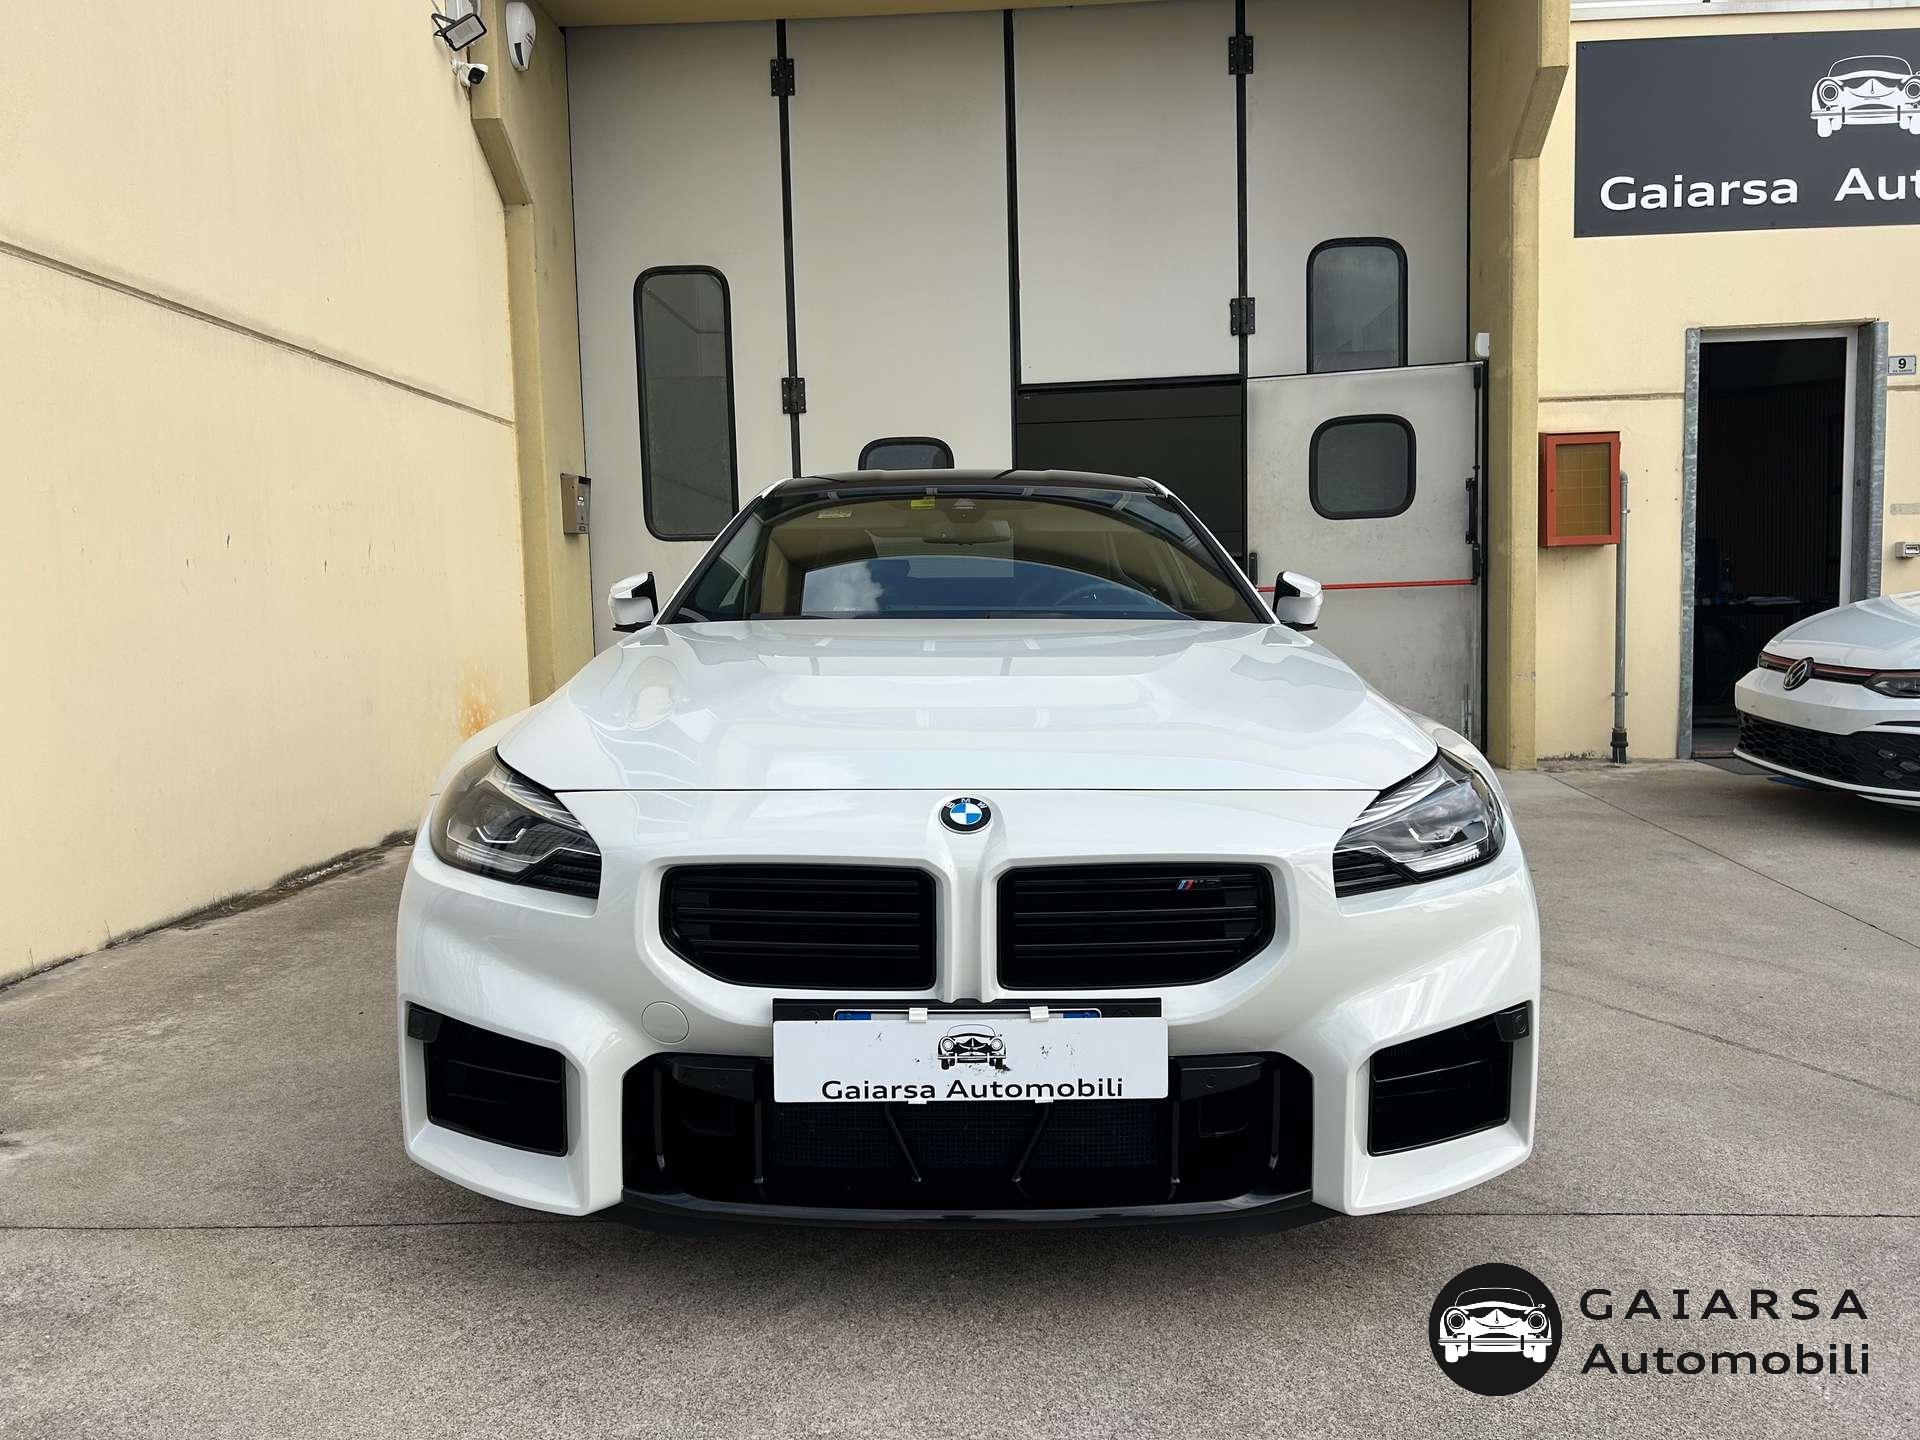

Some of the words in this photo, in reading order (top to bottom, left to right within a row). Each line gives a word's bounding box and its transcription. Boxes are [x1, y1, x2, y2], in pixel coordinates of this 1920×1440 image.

[1600, 174, 1798, 211] Gaiarsa
[1898, 358, 1906, 369] 9
[944, 798, 987, 809] BMW
[821, 1079, 936, 1100] Gaiarsa
[946, 1077, 1123, 1099] Automobili
